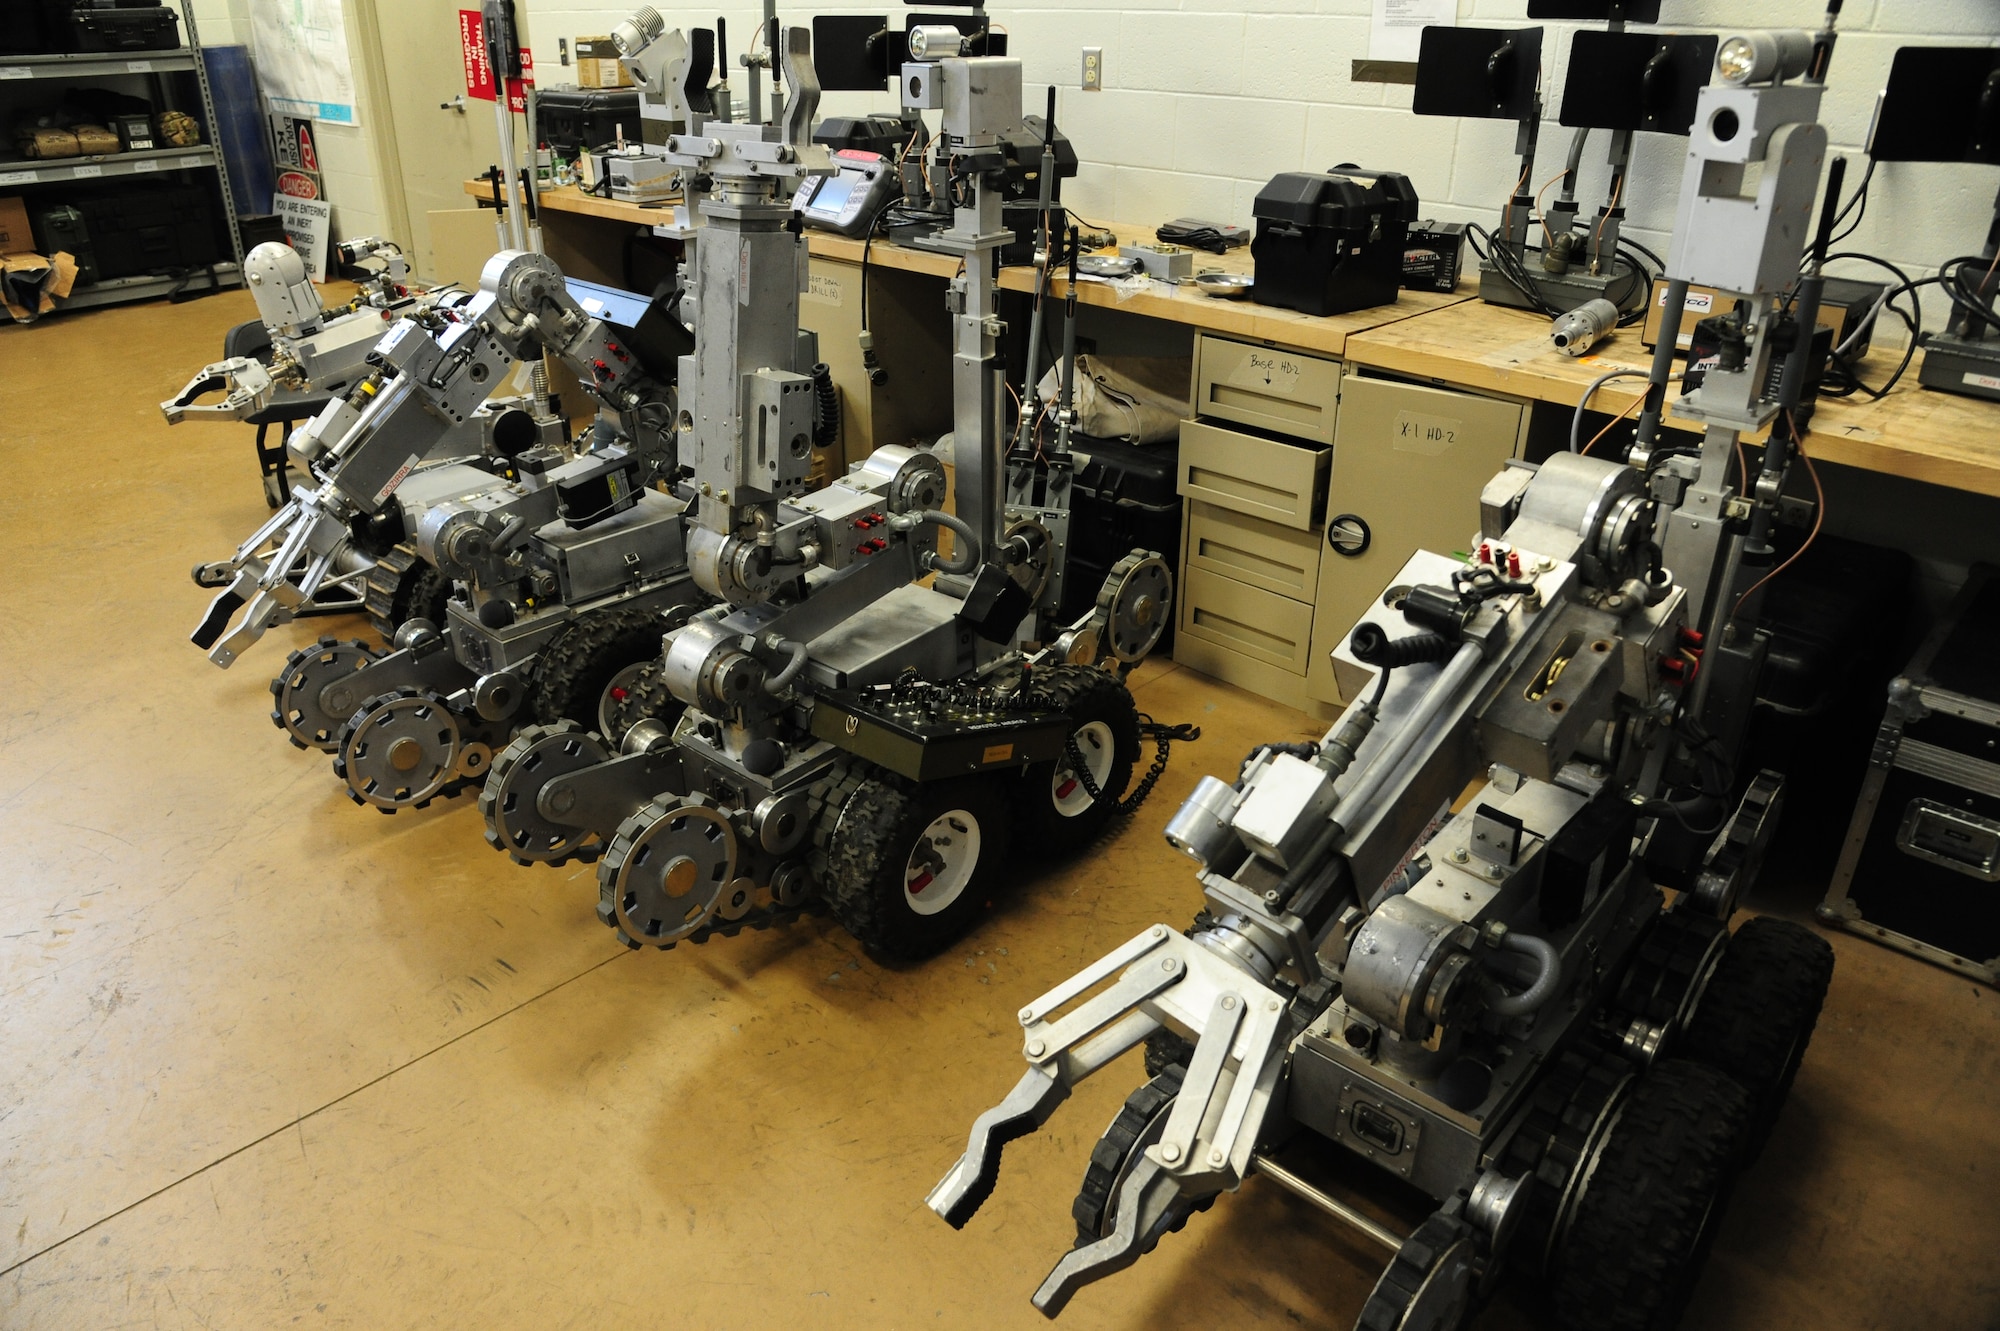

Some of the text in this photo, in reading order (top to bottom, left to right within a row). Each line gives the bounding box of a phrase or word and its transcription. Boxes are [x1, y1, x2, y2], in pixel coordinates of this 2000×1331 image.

[461, 14, 475, 88] PROGRESS
[471, 46, 478, 59] IN
[475, 22, 487, 85] TRAINING
[520, 53, 530, 65] OD
[282, 177, 312, 197] DANGER
[276, 199, 327, 218] YOU ARE ENTERING
[287, 215, 312, 229] AN INERT
[1250, 354, 1299, 374] Base HD-2
[1401, 422, 1455, 443] X-1 HD-2
[381, 465, 410, 497] GOZIRRA
[1383, 818, 1437, 891] PINKERTON
